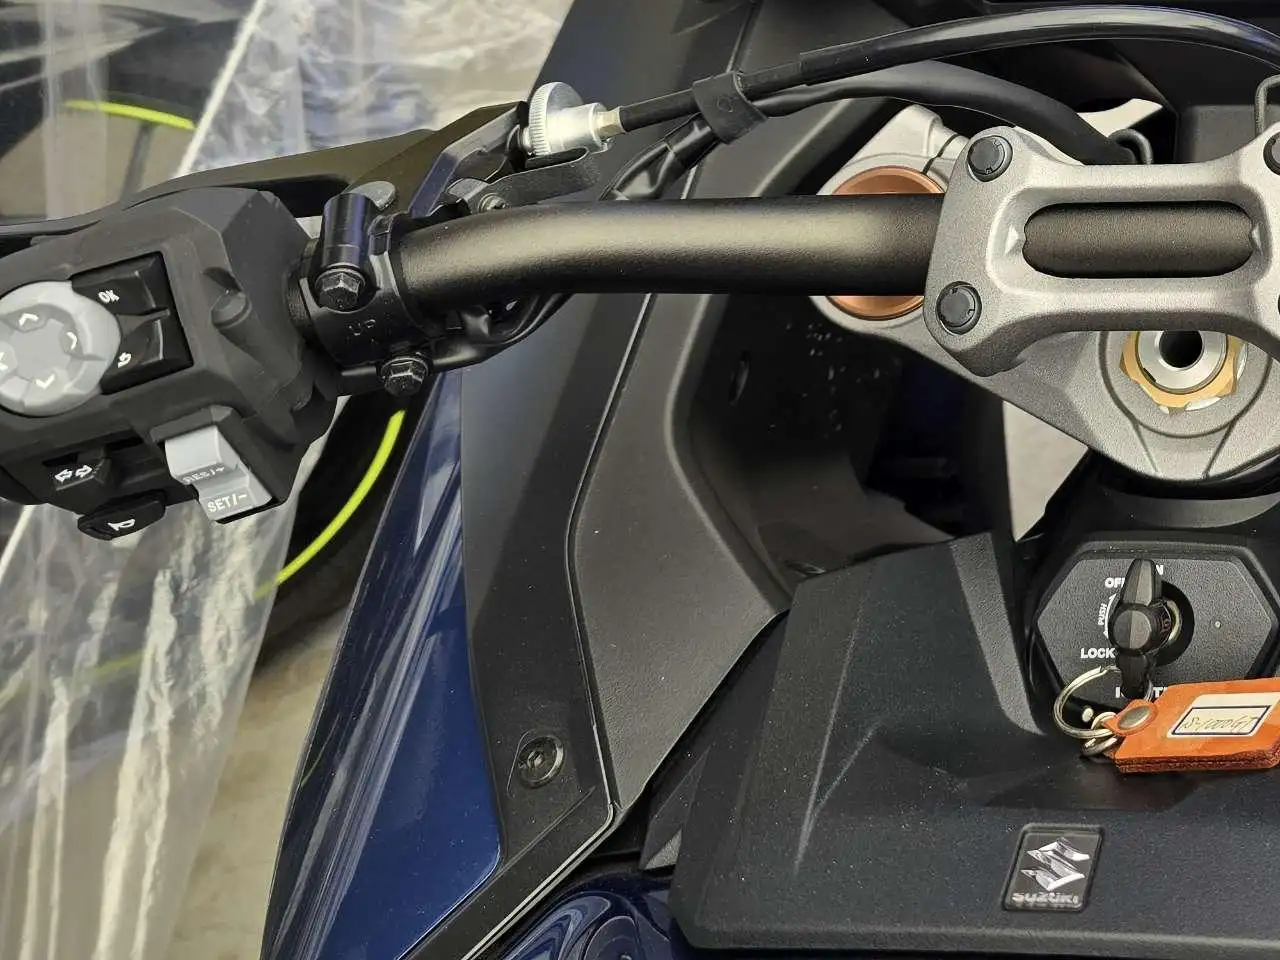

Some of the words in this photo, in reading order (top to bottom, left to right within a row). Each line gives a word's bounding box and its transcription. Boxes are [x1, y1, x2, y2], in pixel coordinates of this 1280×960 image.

[98, 290, 120, 304] OK
[207, 493, 247, 512] SET/-
[1097, 603, 1107, 626] PUSH
[1080, 647, 1116, 659] LOCK
[1012, 892, 1079, 904] SUZUKI
